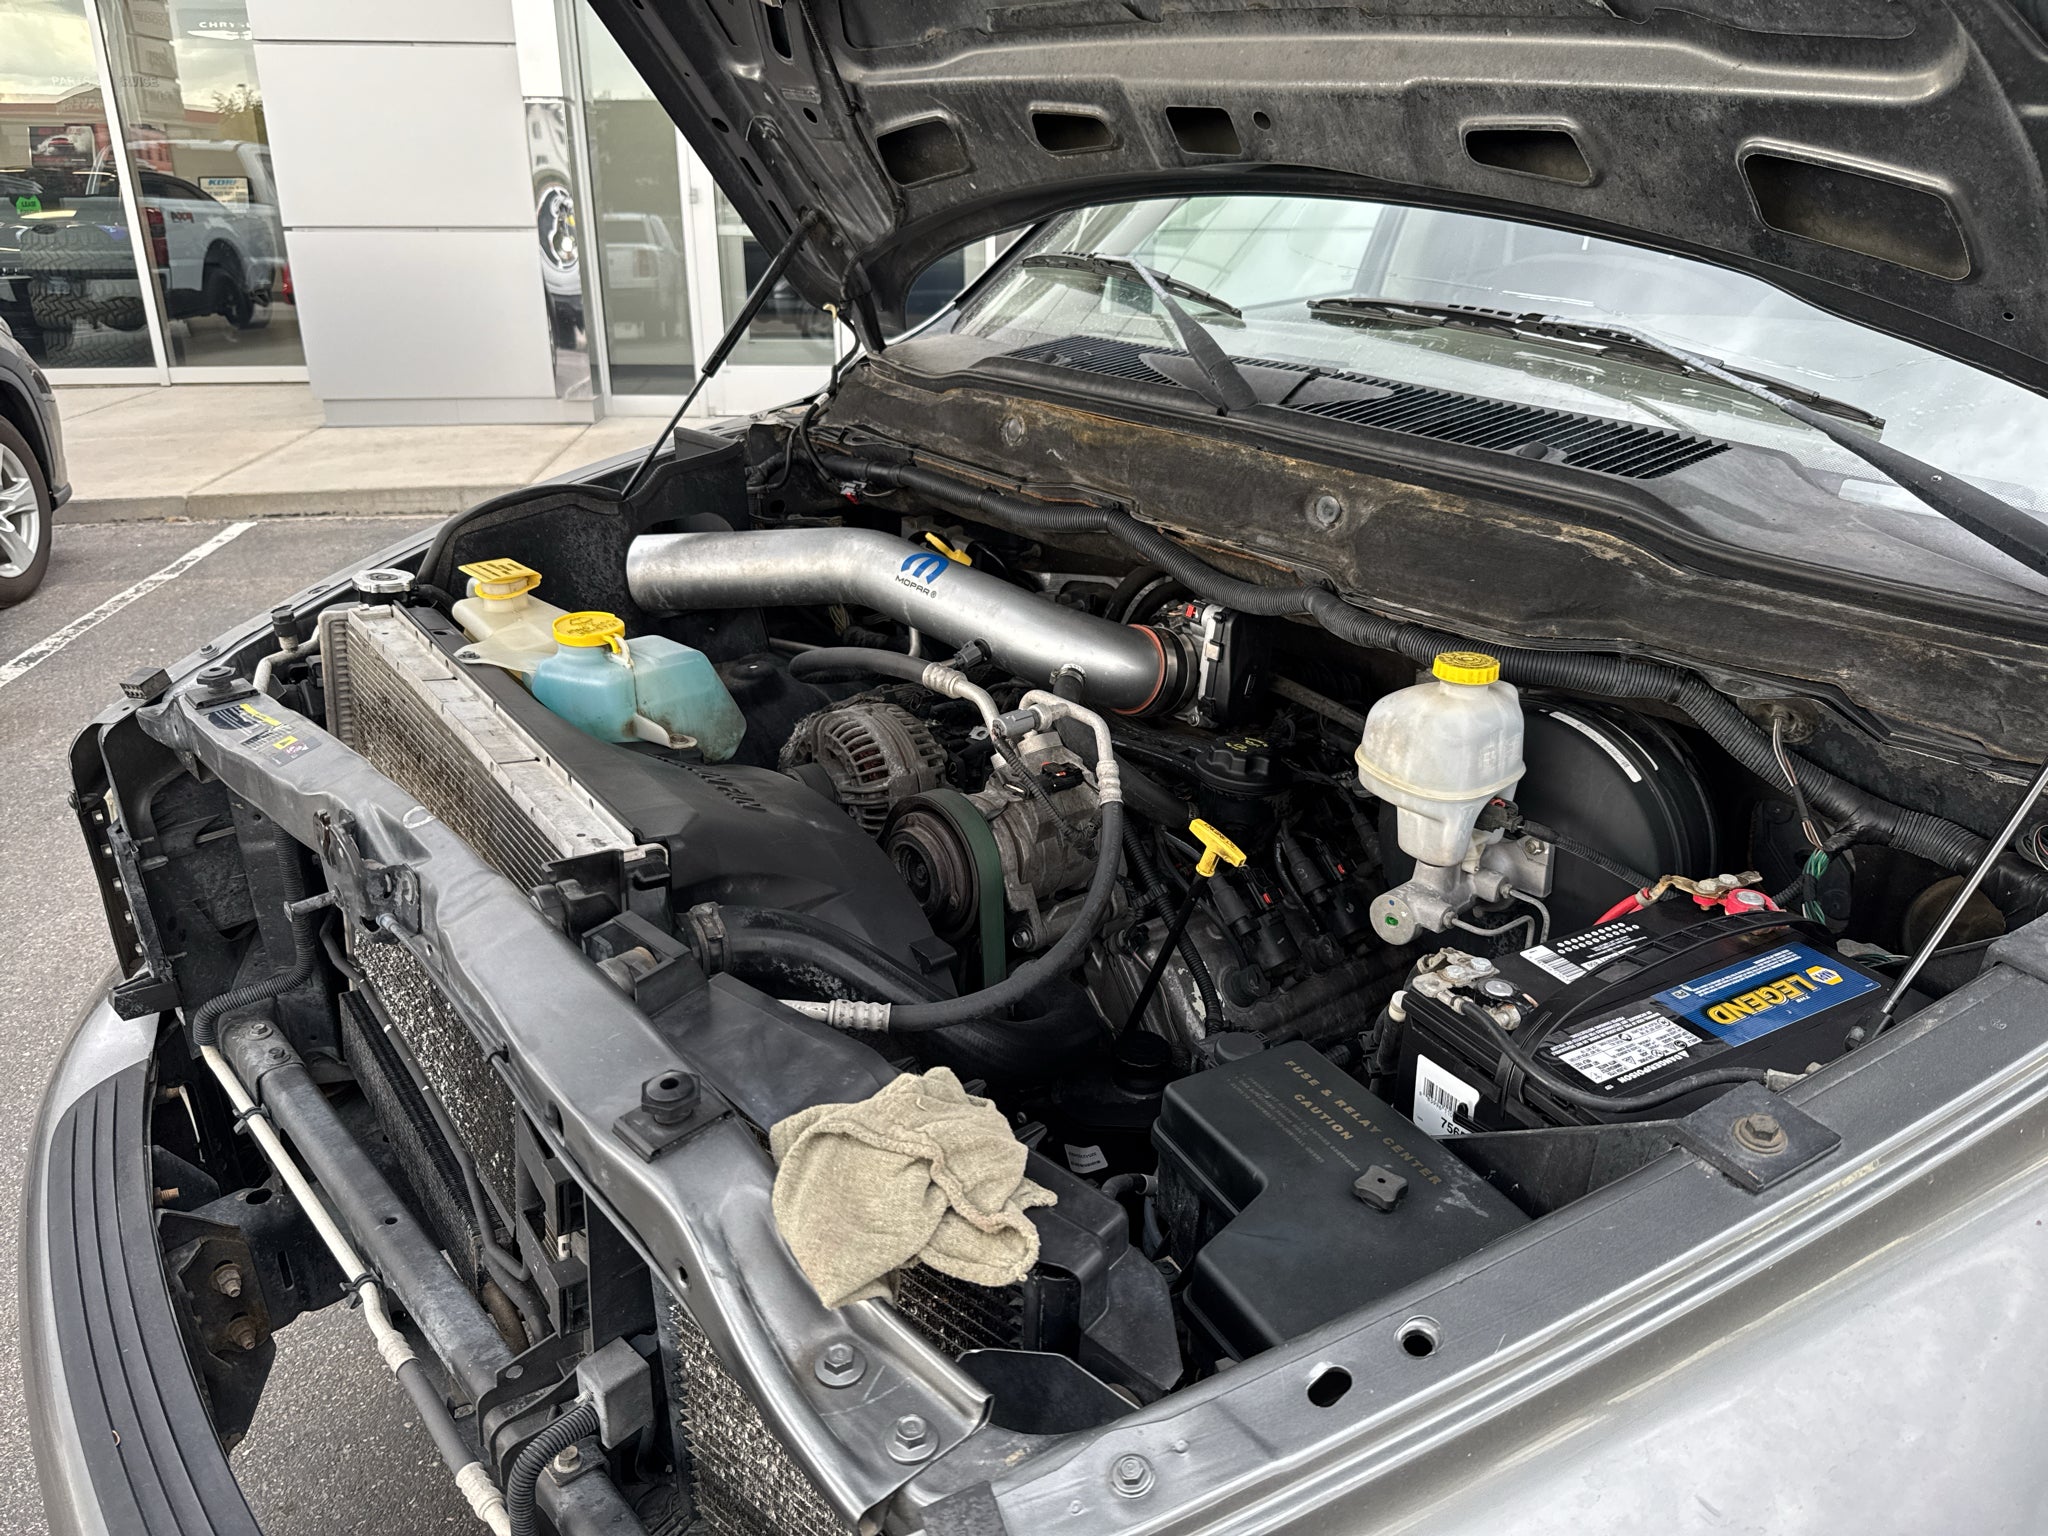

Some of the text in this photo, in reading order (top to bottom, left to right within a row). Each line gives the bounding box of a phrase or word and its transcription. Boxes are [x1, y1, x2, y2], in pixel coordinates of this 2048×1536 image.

[1812, 969, 1836, 981] NAPA
[1705, 973, 1819, 1026] LEGEND
[1617, 1054, 1683, 1083] DANGER/POISON
[1284, 1060, 1443, 1185] FUSE & RELAY CENTER
[1294, 1094, 1354, 1140] CAUTION
[1441, 1117, 1466, 1135] 756
